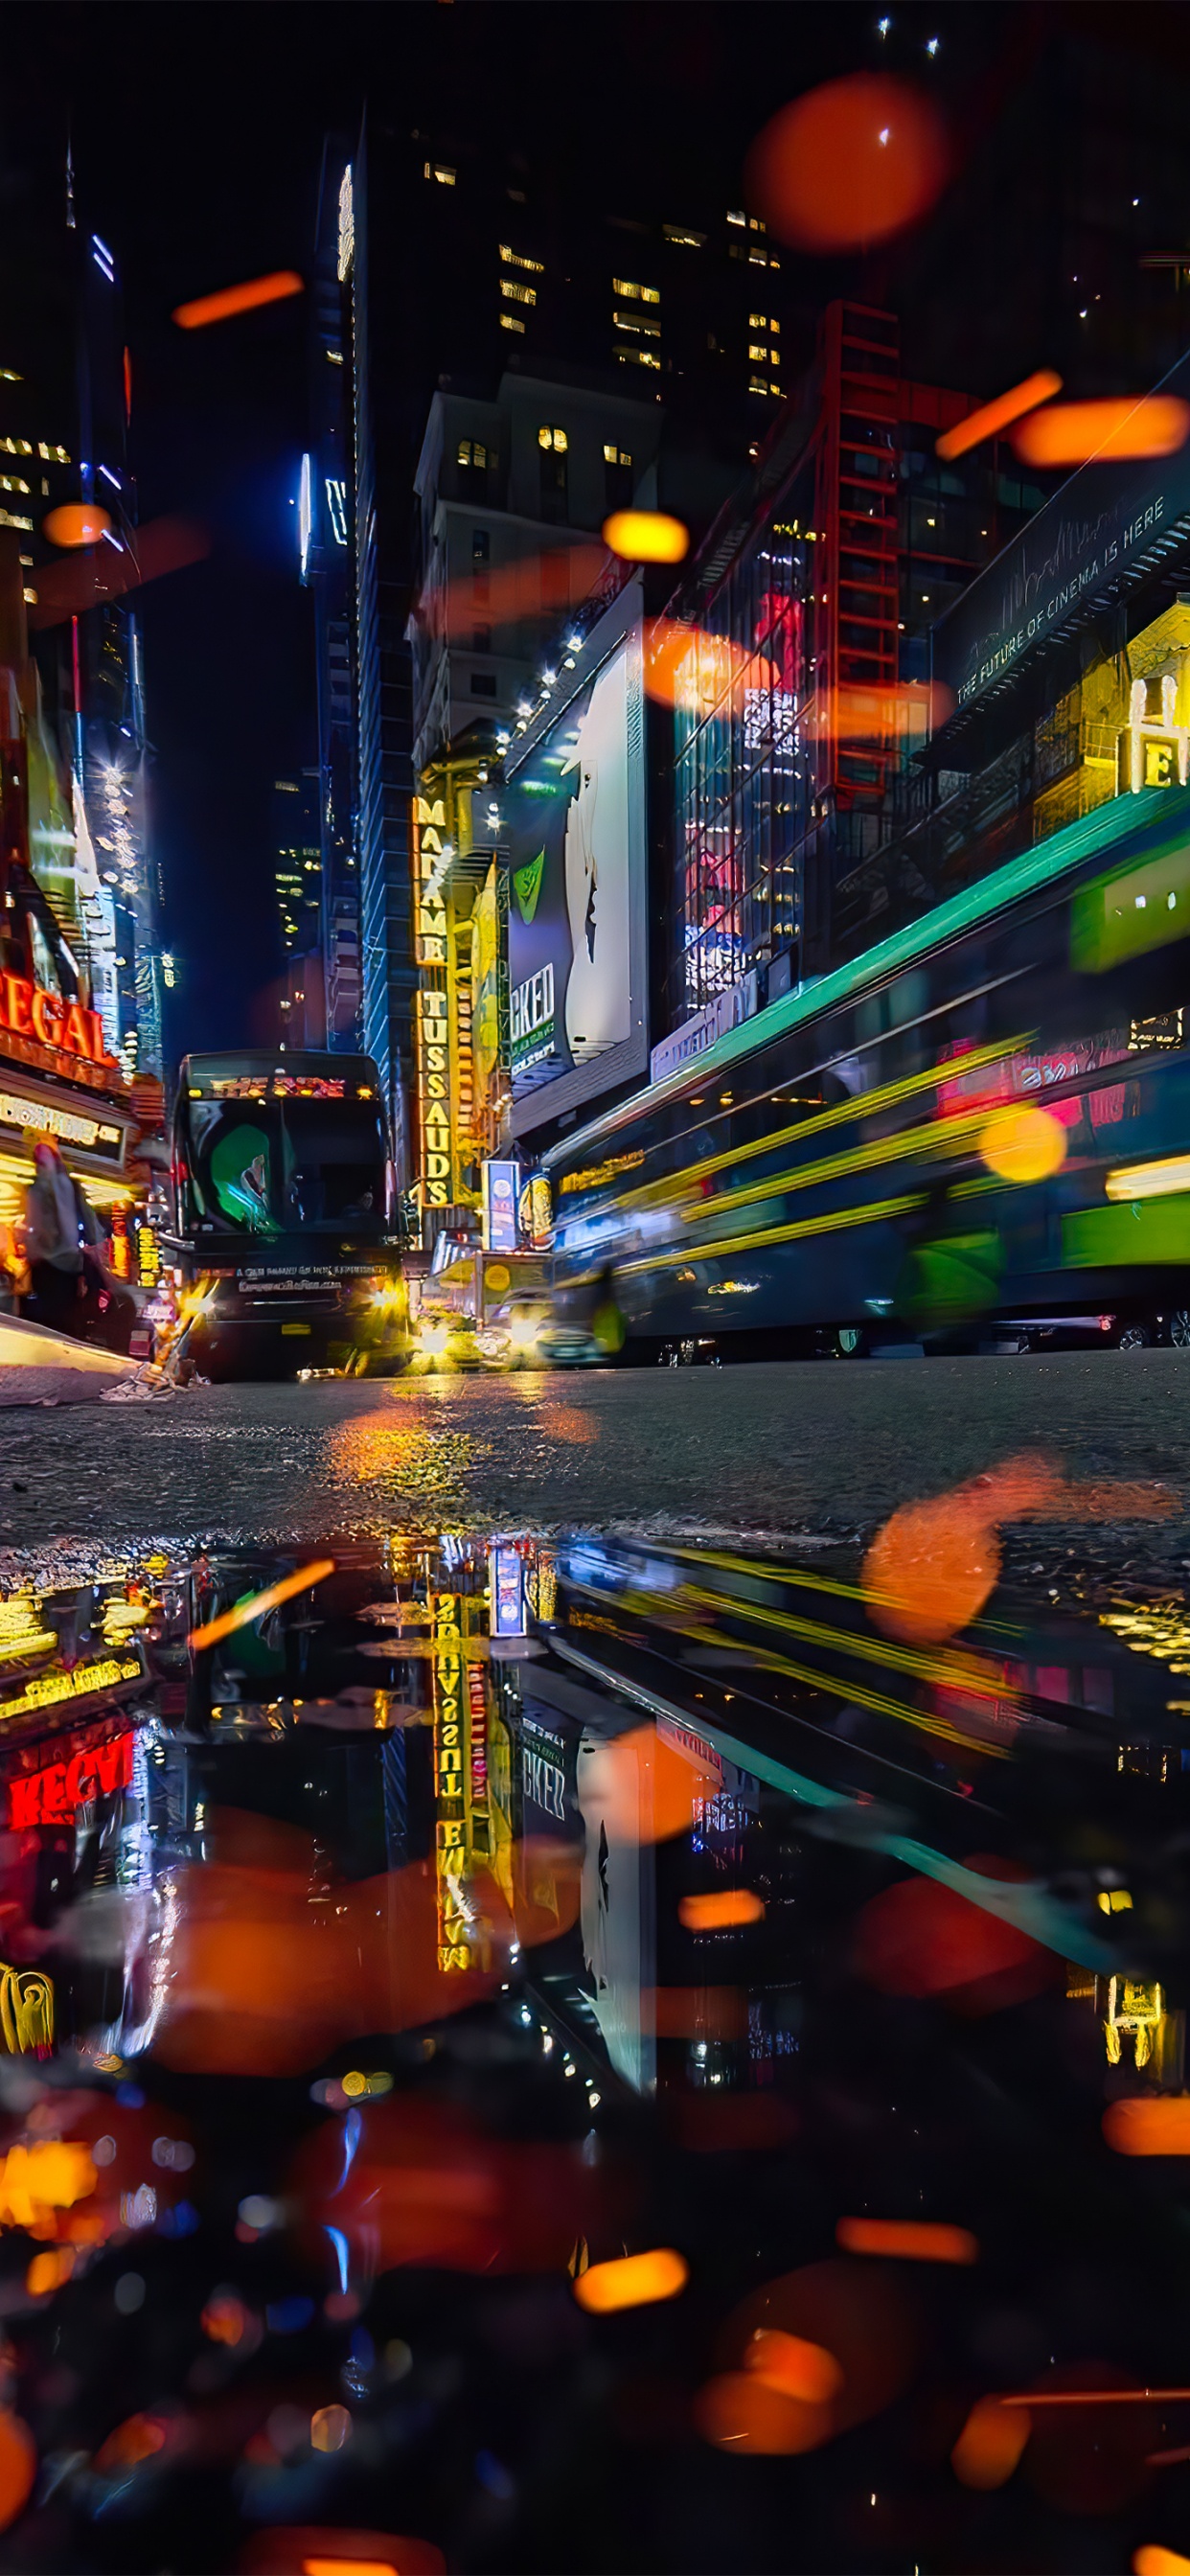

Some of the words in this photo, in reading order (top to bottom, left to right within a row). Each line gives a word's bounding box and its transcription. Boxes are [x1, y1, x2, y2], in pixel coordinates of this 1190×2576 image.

[957, 674, 976, 704] THE
[980, 629, 1024, 683] FUTURE
[1027, 610, 1044, 638] OF
[1046, 560, 1099, 619] CINEMA
[1105, 540, 1118, 567] IS
[1124, 495, 1164, 548] HERE
[0, 971, 119, 1068] EGAL
